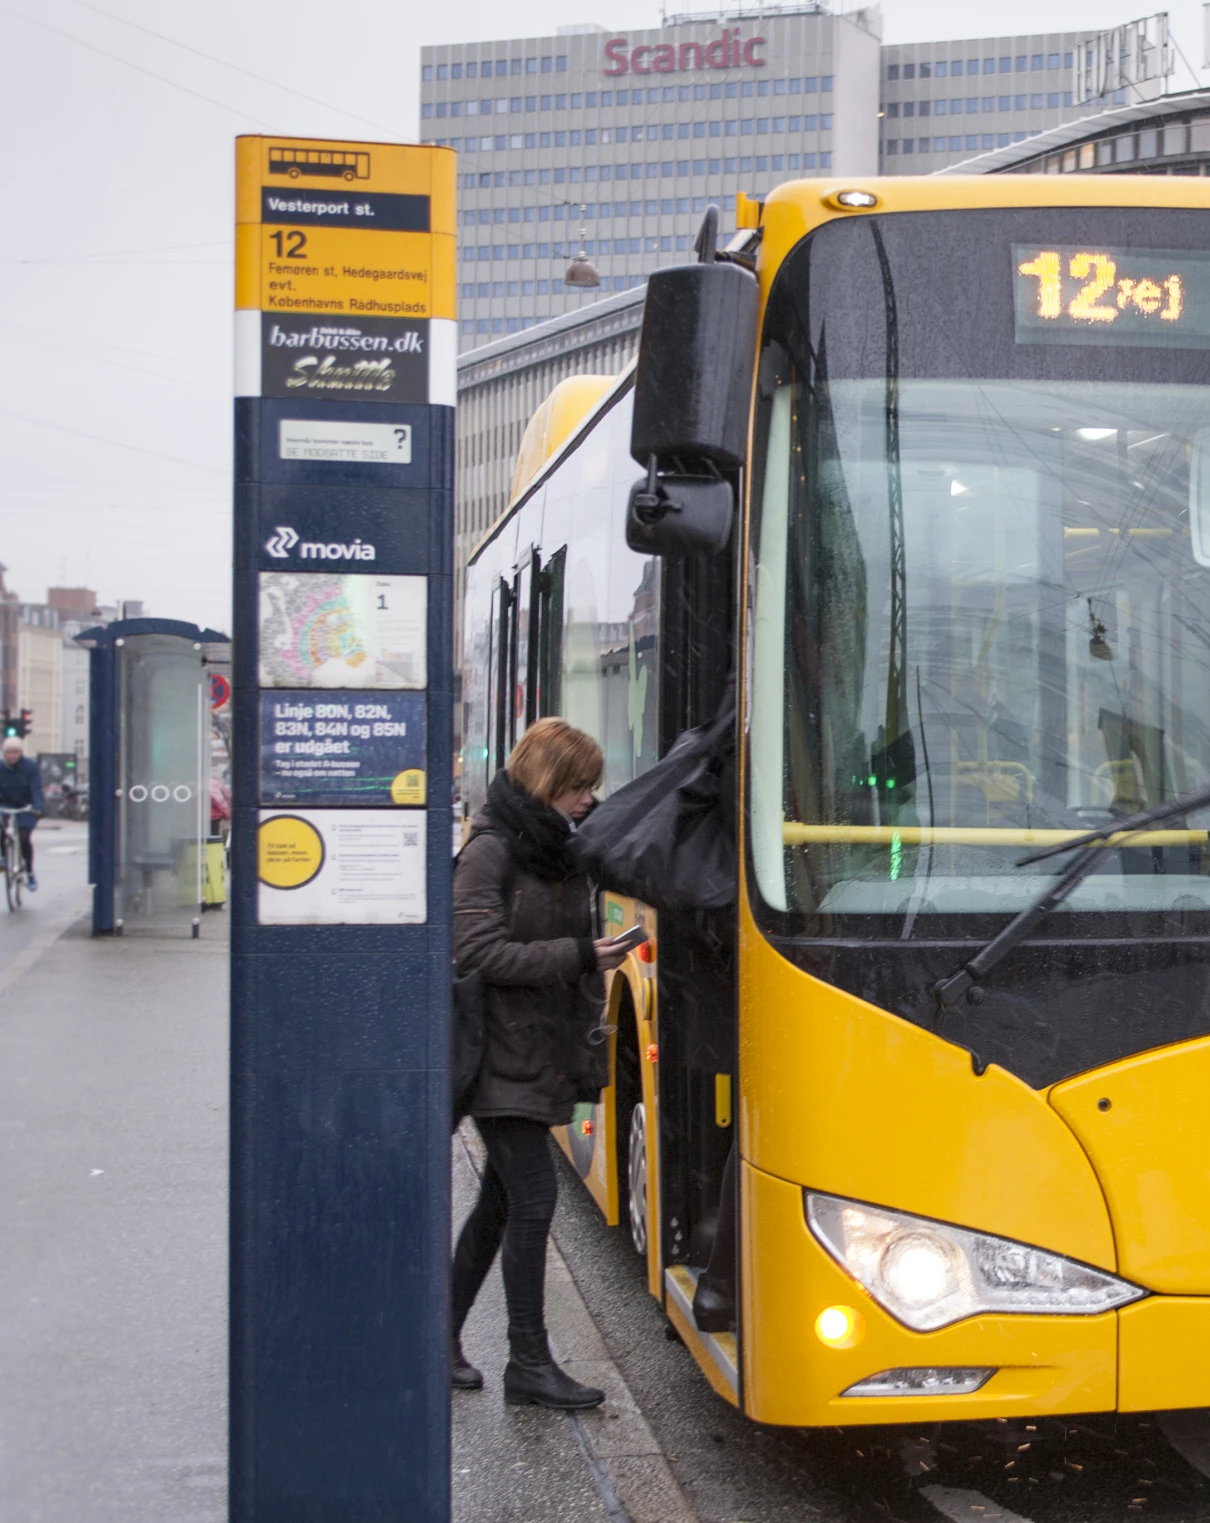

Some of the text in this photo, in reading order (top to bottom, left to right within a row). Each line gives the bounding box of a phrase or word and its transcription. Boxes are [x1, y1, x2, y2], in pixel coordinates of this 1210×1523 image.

[604, 28, 766, 76] Scandic
[268, 198, 375, 216] Vesterport st.
[269, 230, 308, 259] 12
[343, 266, 428, 284] Hedegaardsvej
[268, 280, 297, 291] evt.
[1018, 251, 1118, 323] 12
[268, 295, 344, 309] Københavns
[270, 326, 424, 353] barbussen.dk
[394, 428, 407, 450] ?
[301, 539, 376, 560] movia
[377, 594, 389, 610] 1
[275, 703, 393, 720] Linje 80N, 82N,
[275, 721, 312, 738] 83N,
[350, 725, 370, 739] og
[373, 722, 406, 737] 85N
[275, 738, 351, 756] er udgået
